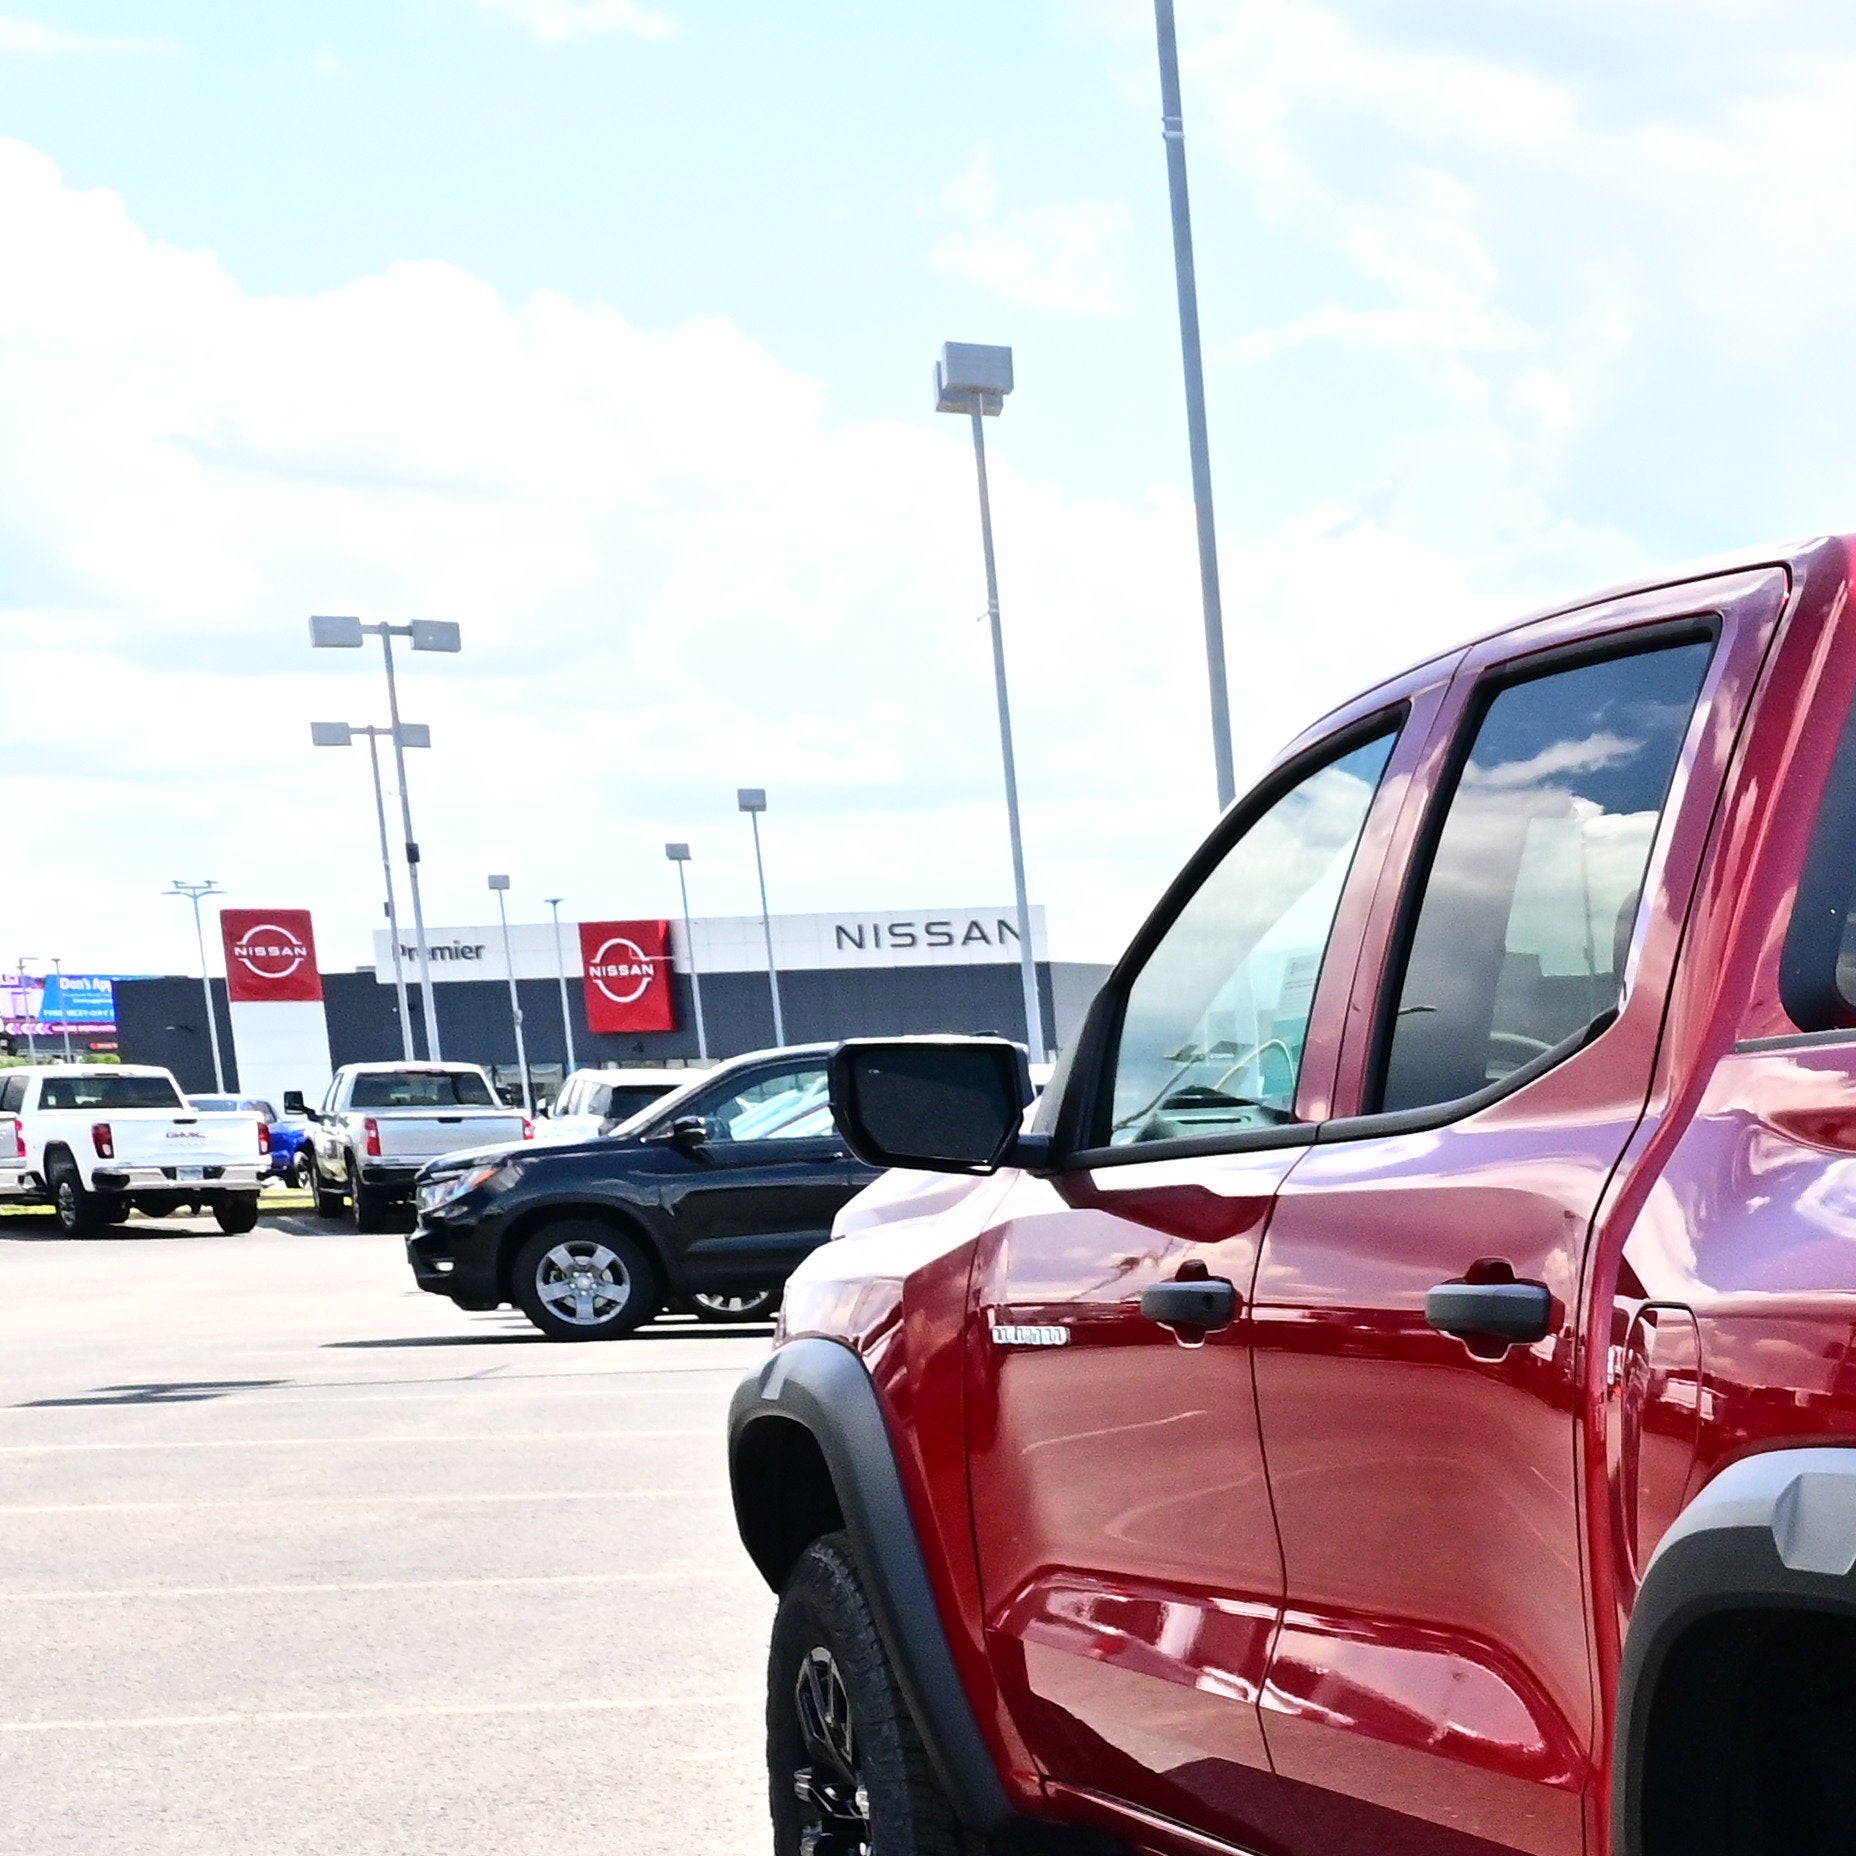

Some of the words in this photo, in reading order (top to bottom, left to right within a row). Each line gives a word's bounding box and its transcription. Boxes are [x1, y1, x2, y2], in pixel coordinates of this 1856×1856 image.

[834, 919, 1021, 950] NISSAN
[234, 946, 307, 957] NISSAN
[393, 940, 485, 962] Prmier
[589, 964, 654, 978] NISSAN
